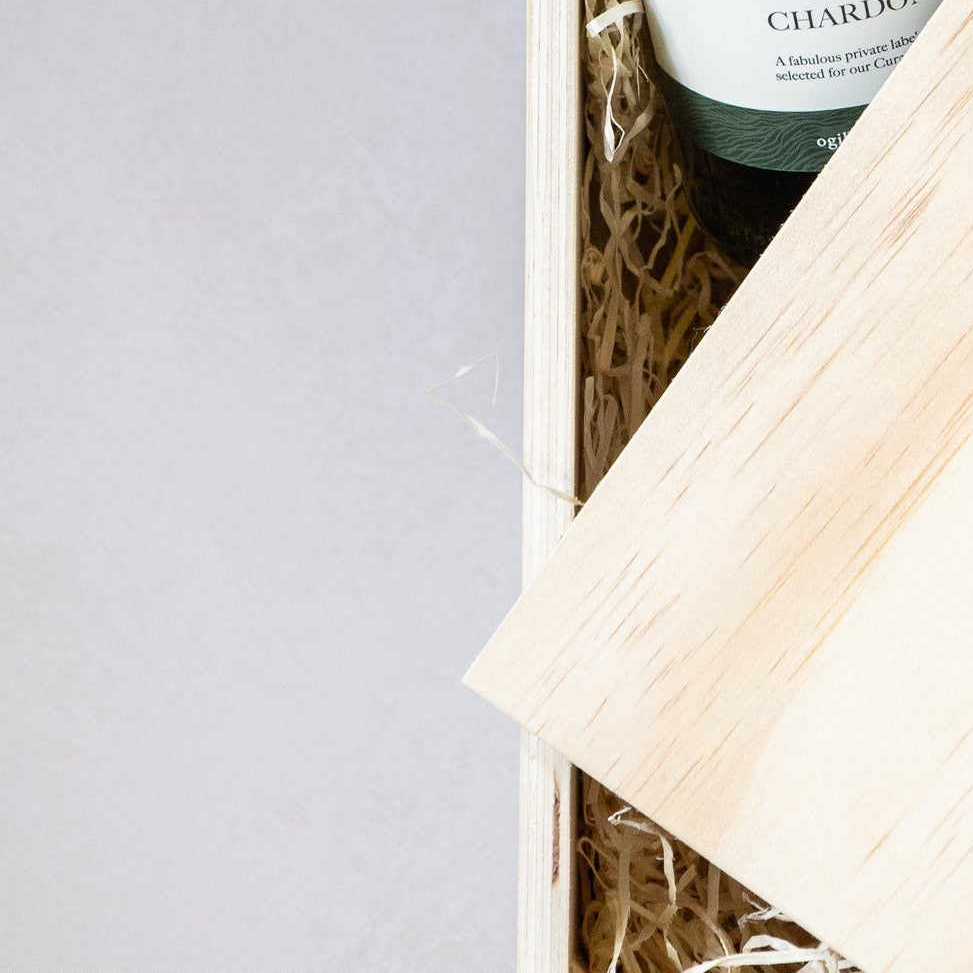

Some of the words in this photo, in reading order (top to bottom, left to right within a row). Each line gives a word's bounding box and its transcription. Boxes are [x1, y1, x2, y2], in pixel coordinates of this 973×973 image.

[775, 56, 786, 67] A
[788, 52, 842, 67] fabulous
[845, 42, 888, 63] private
[775, 68, 825, 81] selected
[828, 66, 846, 78] for
[849, 63, 871, 75] our
